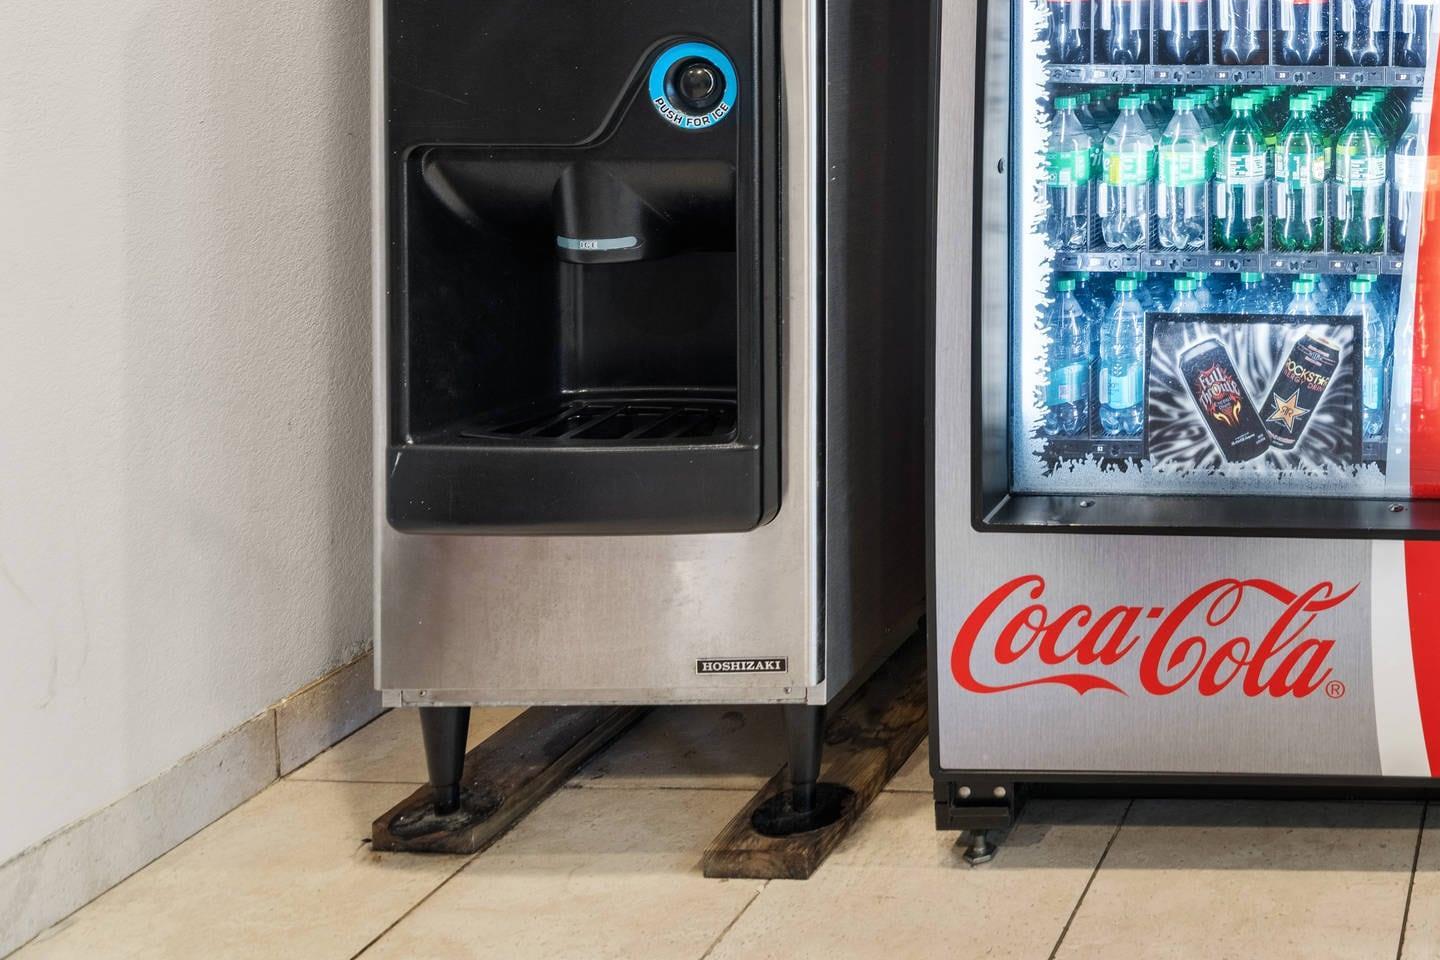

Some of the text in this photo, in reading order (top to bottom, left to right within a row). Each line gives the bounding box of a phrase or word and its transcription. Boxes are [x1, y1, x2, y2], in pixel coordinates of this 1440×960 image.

[655, 98, 729, 126] PUSH FOR ICE
[950, 574, 1361, 698] Coca-Cola
[702, 660, 781, 671] HOSHIZAKI
